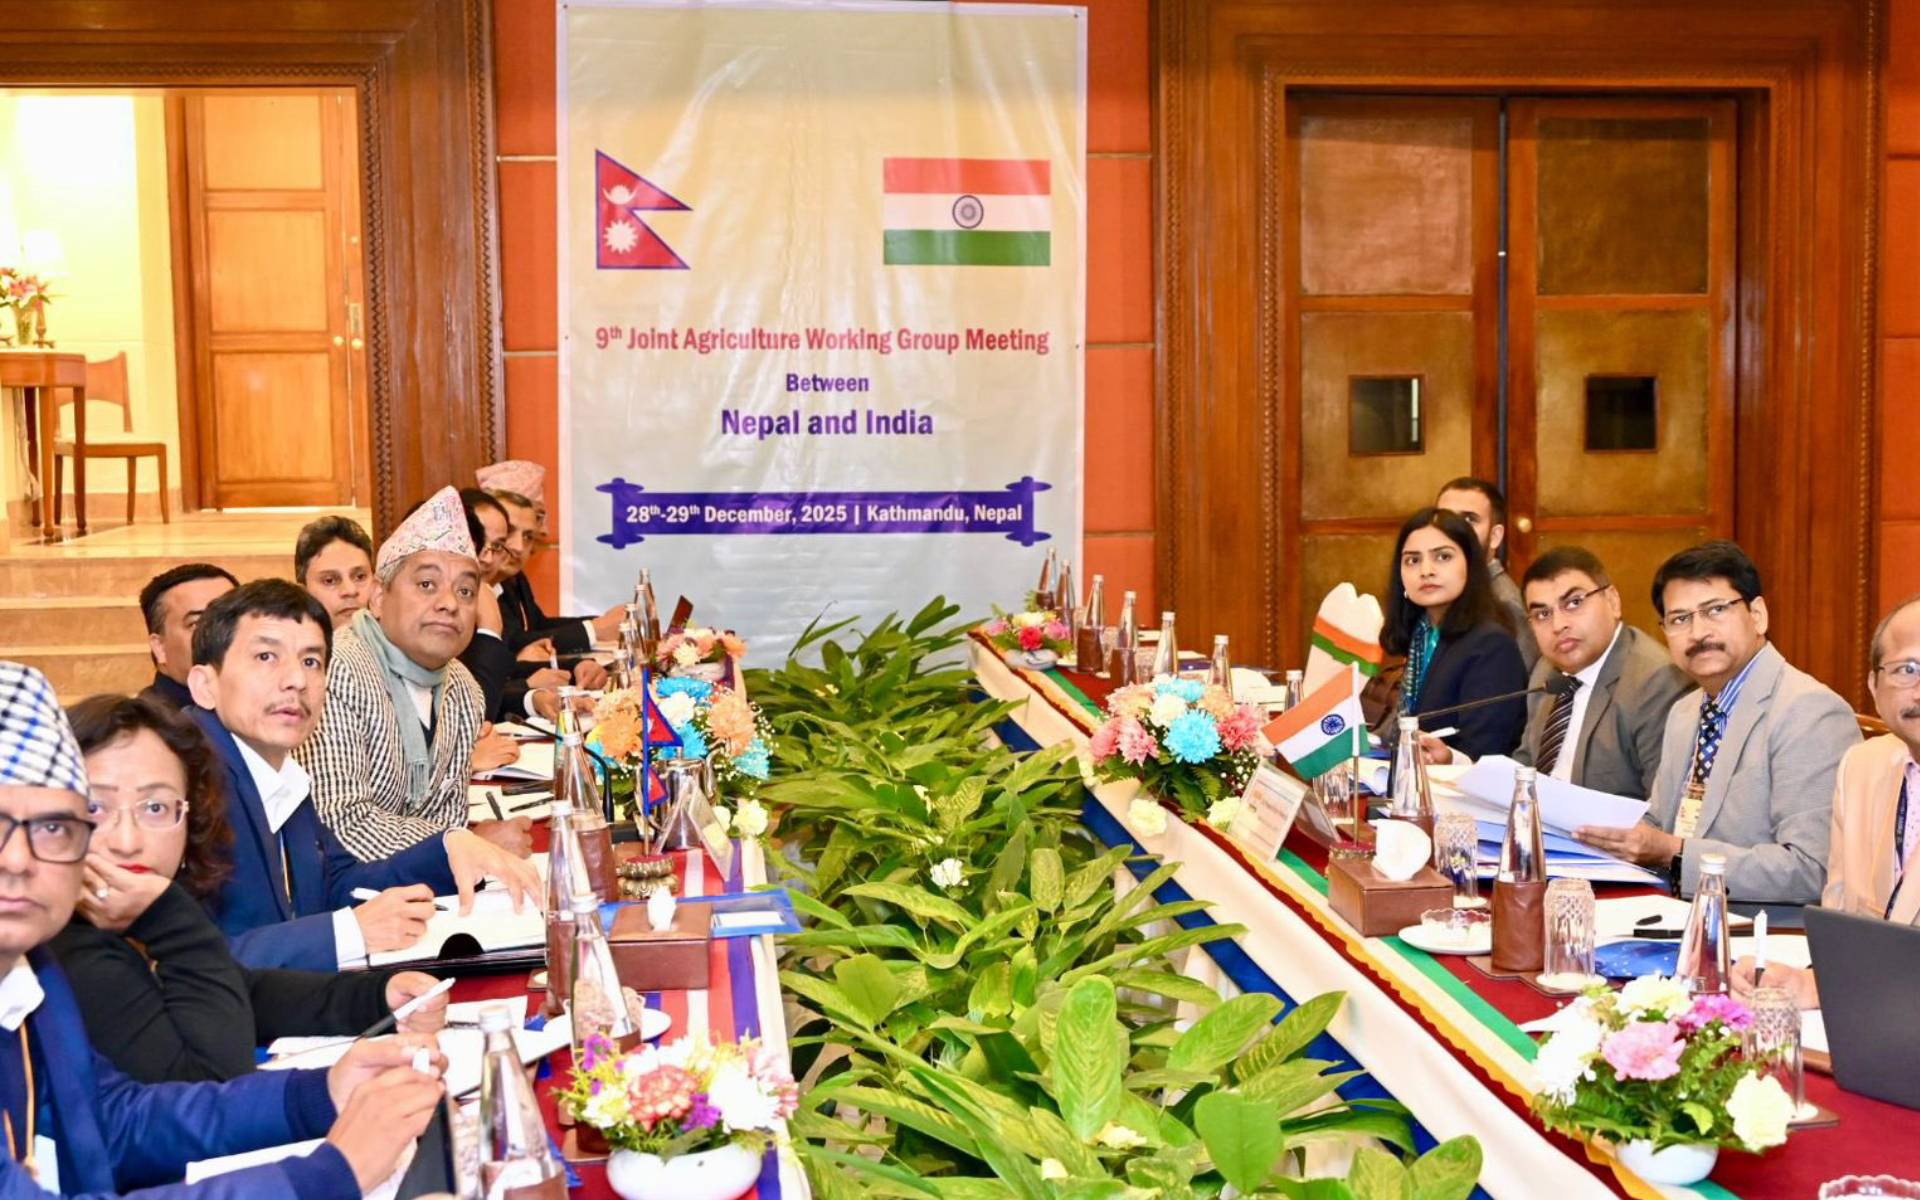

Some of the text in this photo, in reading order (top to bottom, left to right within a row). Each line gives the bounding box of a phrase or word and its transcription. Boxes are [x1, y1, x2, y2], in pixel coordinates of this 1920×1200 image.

[595, 327, 1050, 354] 9th Joint Agriculture Working Group Meeting
[786, 372, 870, 393] Between
[721, 408, 934, 440] Nepal and India
[626, 505, 700, 523] 28th-29th
[704, 505, 797, 526] December,
[801, 505, 848, 523] 2025
[866, 504, 970, 526] Kathmandu,
[974, 504, 1023, 525] Nepal
